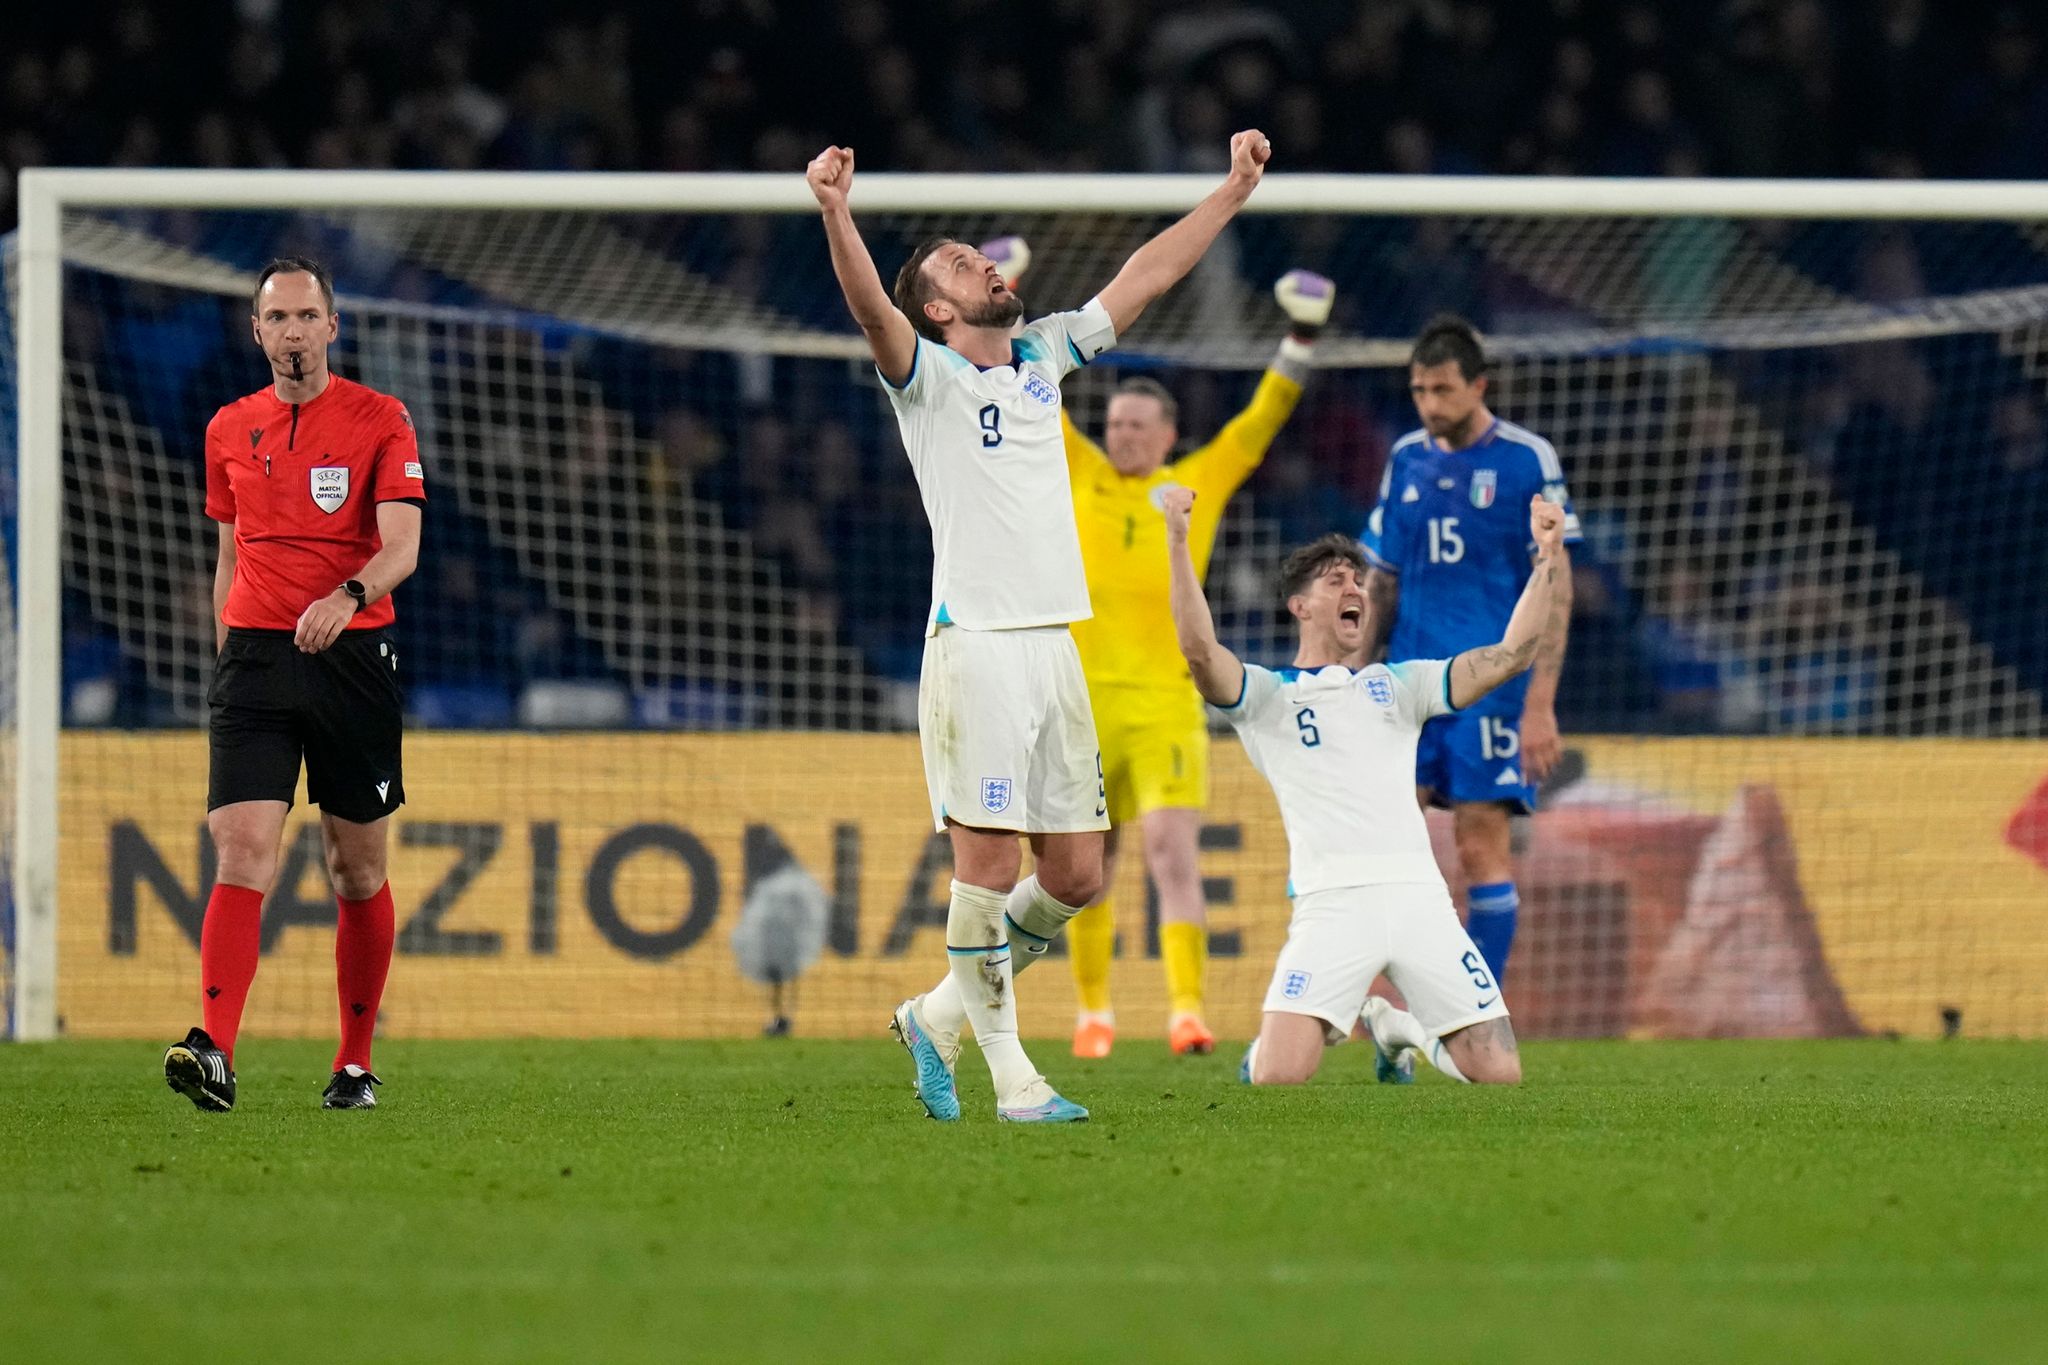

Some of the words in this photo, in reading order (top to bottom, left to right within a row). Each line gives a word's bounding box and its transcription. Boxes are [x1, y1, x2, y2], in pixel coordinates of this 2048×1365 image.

[979, 403, 1001, 447] 9
[318, 472, 340, 480] UEFA
[1427, 518, 1463, 563] 15
[1296, 708, 1320, 748] 5
[1479, 716, 1519, 760] 15
[109, 821, 1242, 956] NAZIONAE
[1461, 951, 1491, 989] 5
